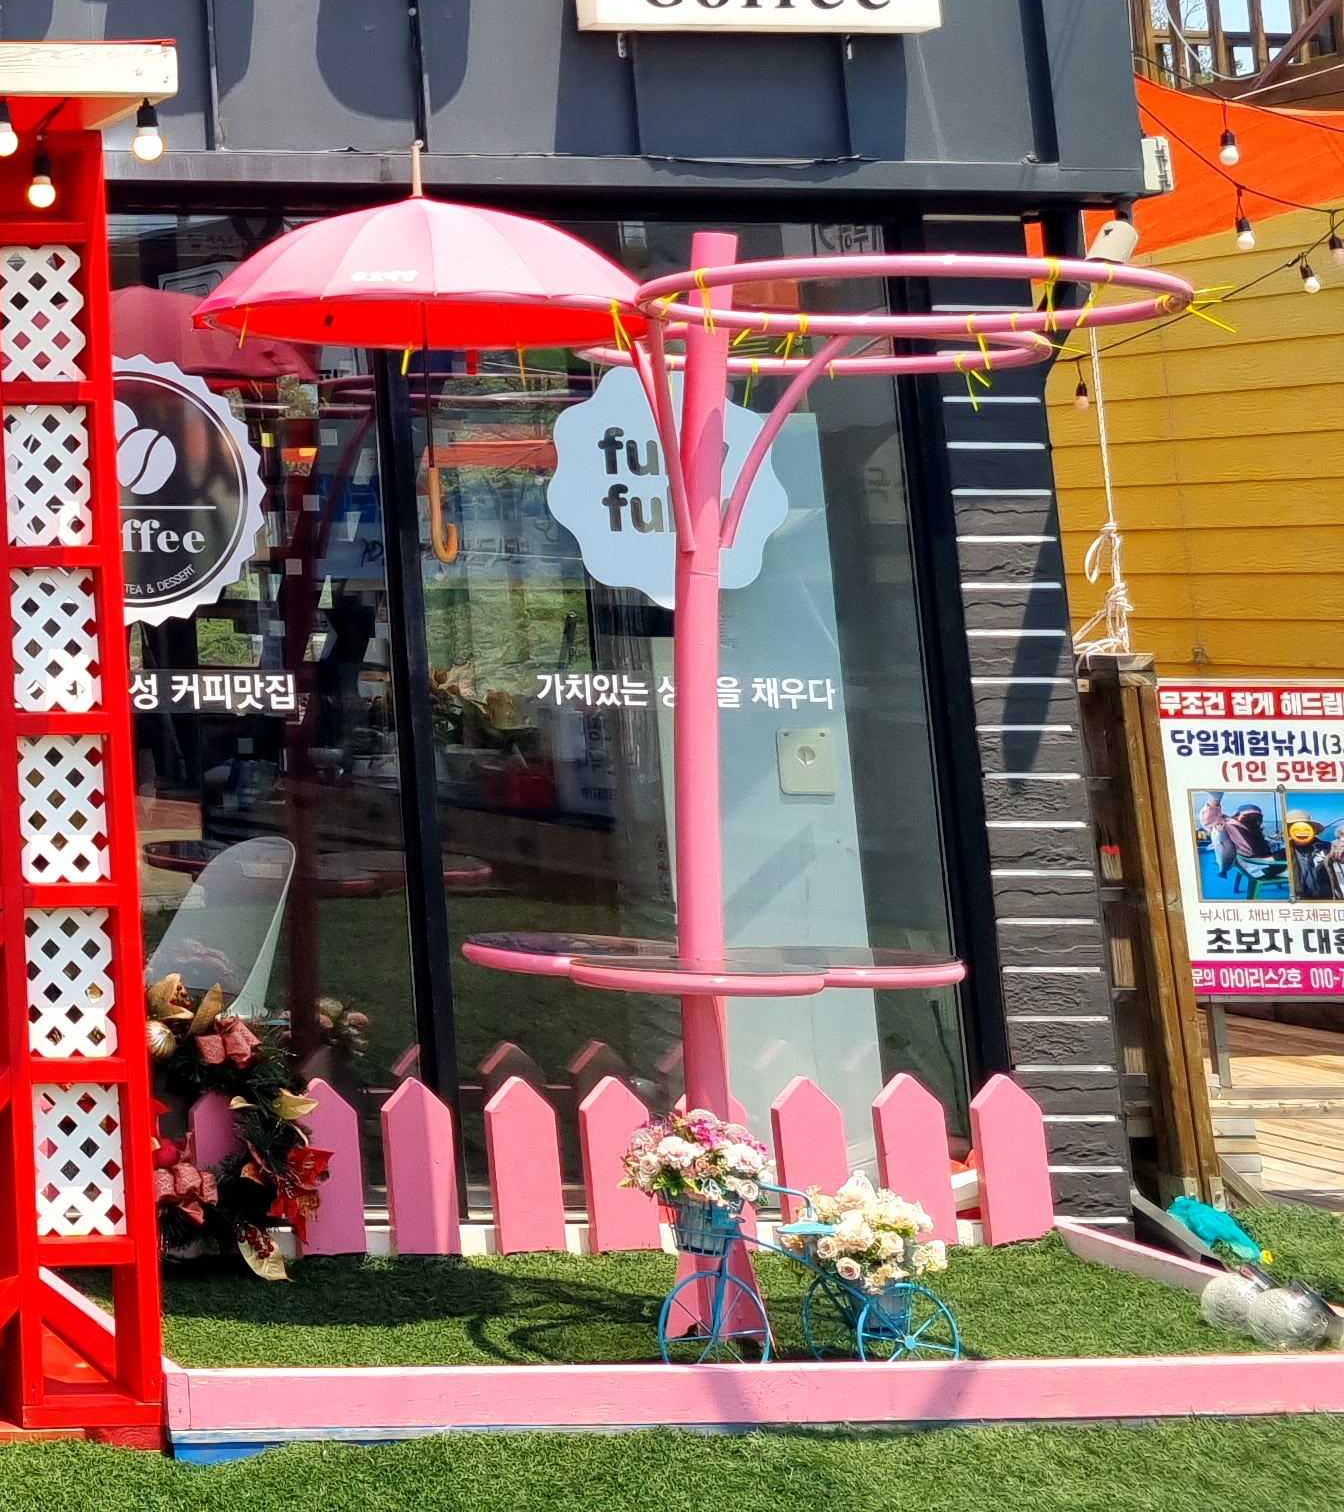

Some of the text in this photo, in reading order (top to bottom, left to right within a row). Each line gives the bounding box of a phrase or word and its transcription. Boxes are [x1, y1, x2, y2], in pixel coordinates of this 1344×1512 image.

[120, 519, 206, 554] ffee
[124, 564, 196, 594] TEA & DESSERT
[127, 673, 297, 710] 성 커피맛집
[536, 673, 649, 707] 가치있는
[751, 676, 836, 710] 채우다
[1159, 691, 1226, 716] 무조건
[1231, 691, 1274, 716] 잡게
[1170, 729, 1344, 757] 당일체험낚시(3
[1221, 760, 1267, 783] (1인
[1248, 908, 1274, 922] 채비
[1206, 928, 1294, 955] 초보자
[1191, 968, 1216, 987] 문의
[1219, 967, 1303, 989] 아이리스2호
